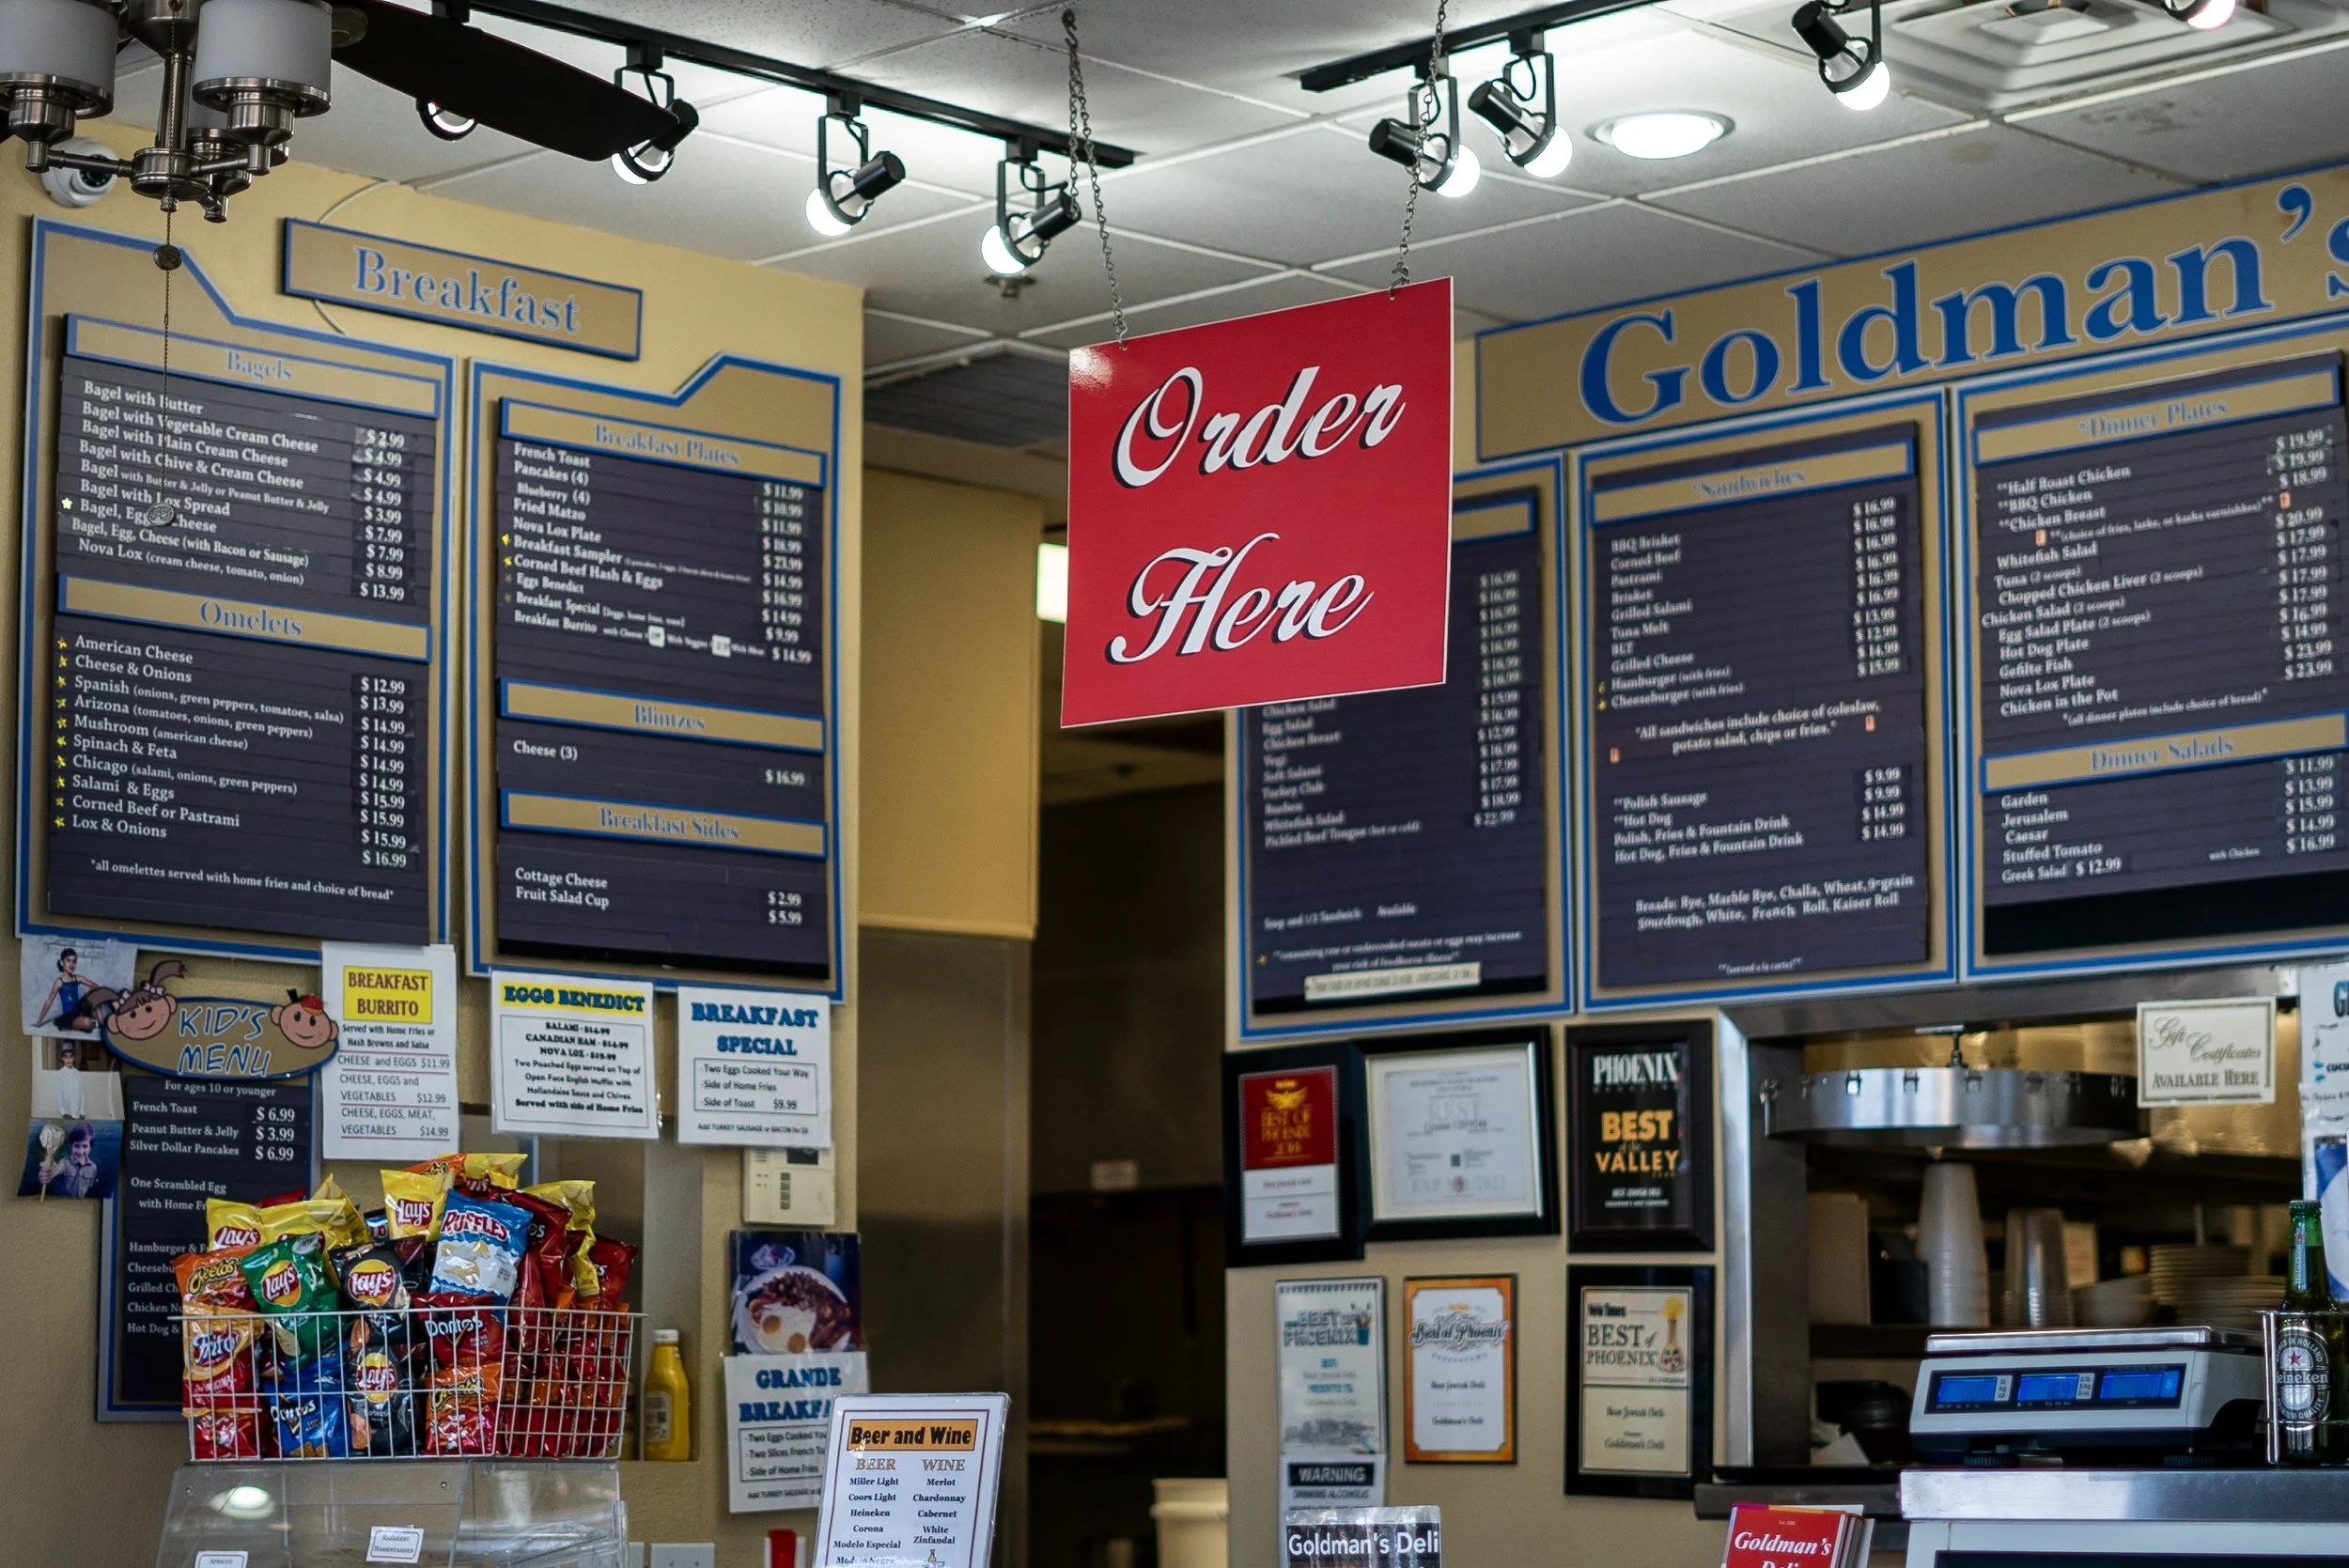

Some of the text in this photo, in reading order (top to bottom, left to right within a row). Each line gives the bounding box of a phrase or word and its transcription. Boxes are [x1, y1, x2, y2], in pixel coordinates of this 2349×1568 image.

[352, 246, 583, 334] Breakfast
[226, 349, 293, 382] Bagels
[2168, 400, 2227, 425] Plates
[83, 400, 319, 453] Bagel with Vegetable Cream Cheese
[1112, 365, 1406, 489] Order
[515, 443, 590, 468] French Toast
[594, 424, 739, 465] Breakfast Plates
[79, 537, 304, 585] Nova Lox (cream cheese, tomato, onion)
[514, 554, 557, 574] Corned
[561, 562, 586, 578] Beef
[589, 566, 618, 582] Hash
[622, 570, 632, 584] &
[636, 571, 663, 590] Eggs
[1105, 532, 1375, 664] Here
[200, 600, 302, 636] Omelets
[75, 635, 193, 664] American Cheese
[76, 654, 192, 683] Cheese & Onions
[75, 675, 344, 724] Spanish (onions, green peppers, tomatoes, salsa)
[2001, 689, 2118, 717] Chicken in the Pot
[634, 705, 706, 730] Blintzes
[514, 740, 578, 761] Cheese (3)
[2091, 736, 2233, 770] Dinner Salads
[72, 775, 175, 801] Salami & Eggs
[72, 795, 240, 827] Corned Beef or Pastrami
[2001, 793, 2048, 809] Garden
[72, 815, 167, 839] Lox & Onions
[600, 807, 739, 840] Breakfast Sides
[2002, 809, 2068, 828] Jerusalem
[2006, 829, 2048, 845] Caesar
[112, 863, 165, 878] omelettes
[168, 868, 203, 882] served
[207, 872, 230, 884] with
[233, 874, 262, 888] home
[265, 877, 288, 891] fries
[291, 879, 310, 893] and
[313, 882, 345, 896] choice
[349, 885, 359, 897] of
[515, 867, 607, 889] Cottage Cheese
[516, 886, 609, 909] Fruit Salad Cup
[348, 972, 428, 992] BREAKFAST
[357, 999, 418, 1017] BURRITO
[505, 986, 645, 1012] EGGS BENEDICT
[179, 1005, 269, 1041] KID'S
[691, 1002, 818, 1028] BREAKFAST
[717, 1035, 797, 1056] SPECIAL
[2149, 1017, 2186, 1050] Gift
[177, 1043, 271, 1077] MENU
[338, 1055, 450, 1069] CHEESE and EGGS $11.99
[1594, 1052, 1678, 1084] PHOENIX
[164, 1080, 276, 1099] For ages 10 or younger
[2153, 1069, 2259, 1090] AVAILABLE HERE
[133, 1102, 197, 1115] French Toast
[341, 1091, 445, 1104] VEGETABLES $12.99
[342, 1108, 377, 1120] CHEESE,
[381, 1109, 406, 1120] EGGS,
[1602, 1110, 1672, 1142] BEST
[132, 1123, 239, 1139] Peanut Butter & Jelly
[1595, 1150, 1679, 1172] VALLEY
[131, 1177, 226, 1194] One Scrambled Egg
[398, 1200, 432, 1226] Lay's
[441, 1210, 510, 1241] RUFFLES
[262, 1262, 299, 1300] Lay's
[350, 1269, 393, 1296] Lay's
[1587, 1324, 1643, 1347] BEST
[1586, 1350, 1658, 1367] PHOENIX
[756, 1367, 842, 1389] GRANDE
[2276, 1373, 2328, 1385] eineken
[850, 1426, 971, 1445] Beer and Wine
[856, 1459, 896, 1470] BEER
[922, 1459, 965, 1471] WINE
[1299, 1467, 1366, 1483] WARNING
[877, 1478, 898, 1487] Light
[875, 1494, 896, 1502] Light
[913, 1495, 966, 1503] Chardonnay
[866, 1541, 900, 1549] Especial
[1288, 1530, 1439, 1556] Goldman's Deli
[1735, 1531, 1831, 1556] Goldman's
